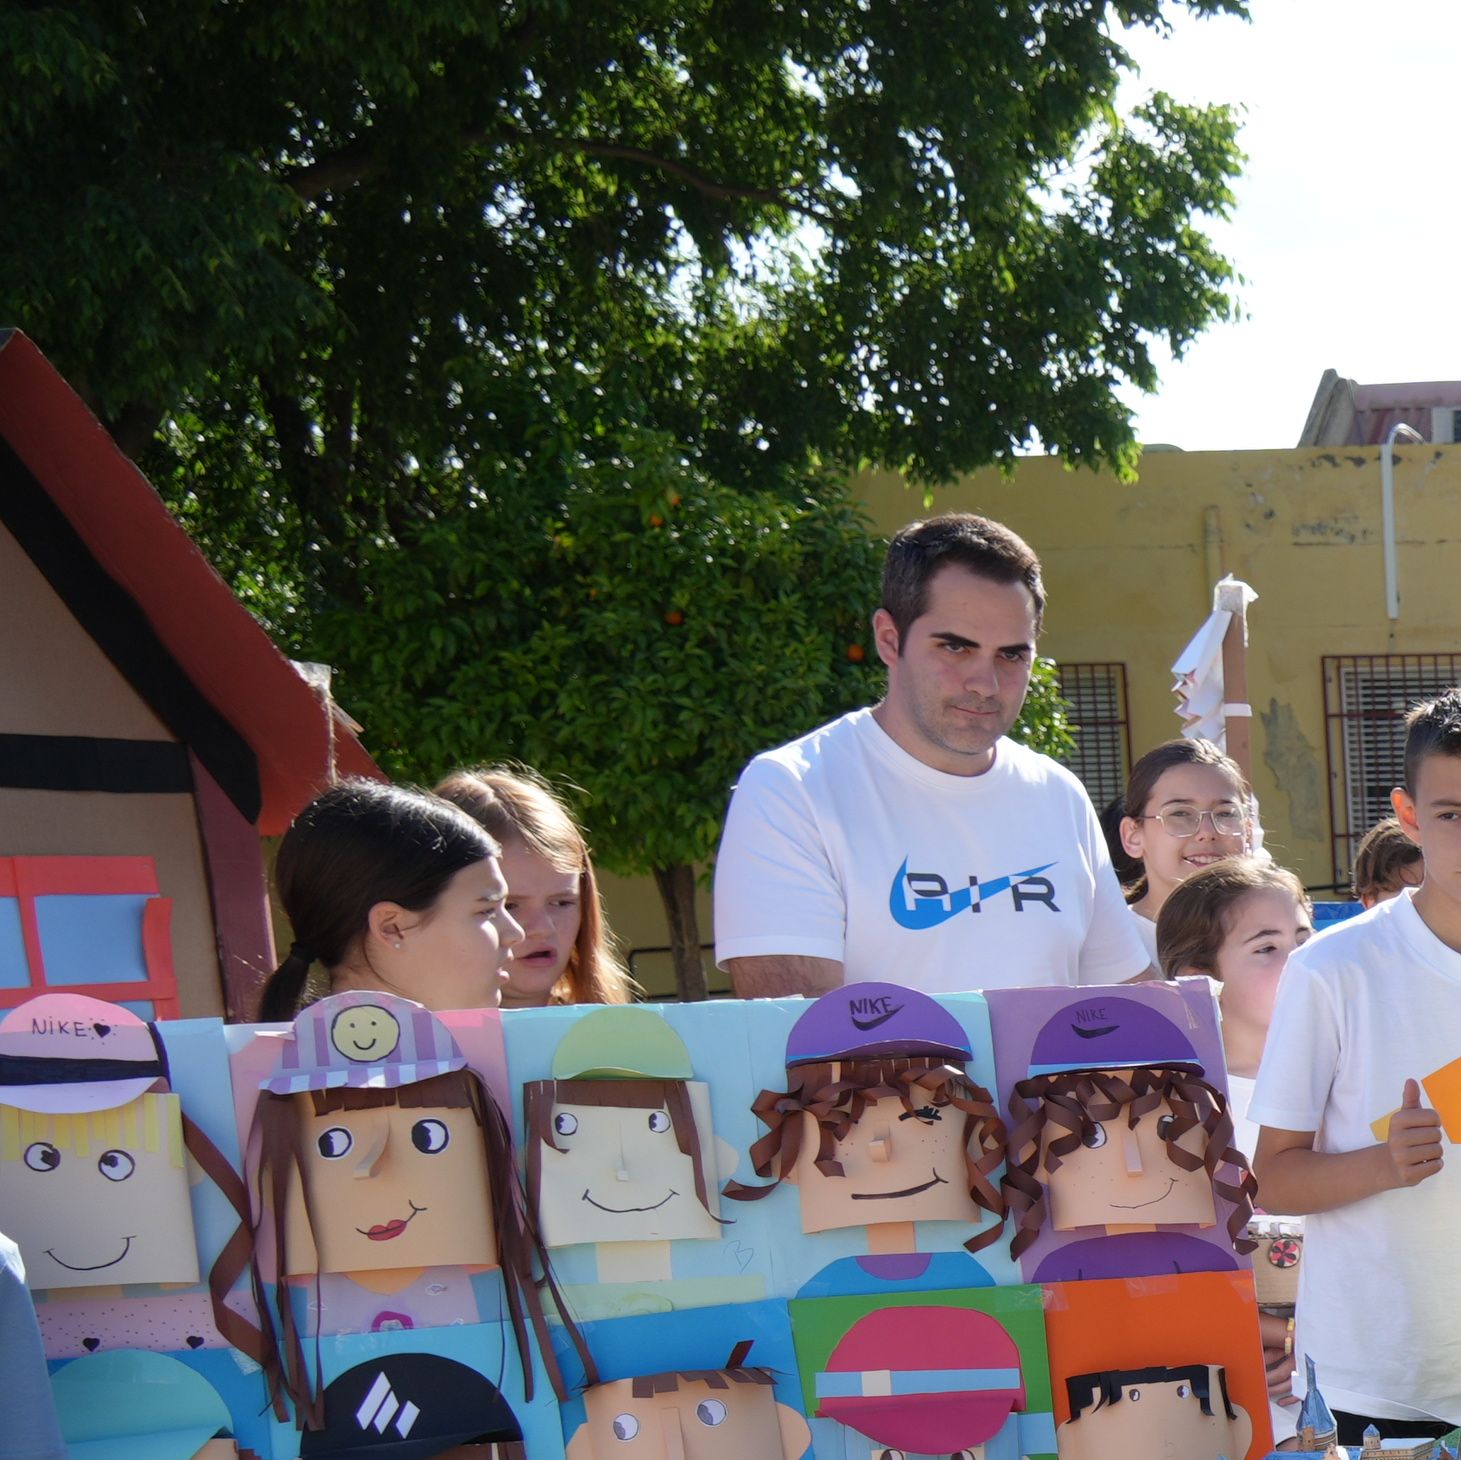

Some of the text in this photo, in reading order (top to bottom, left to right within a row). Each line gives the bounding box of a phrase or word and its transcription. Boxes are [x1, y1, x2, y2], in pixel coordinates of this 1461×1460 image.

[902, 872, 1062, 913] AIR
[850, 996, 893, 1017] NIKE
[1075, 1007, 1109, 1024] NIKE
